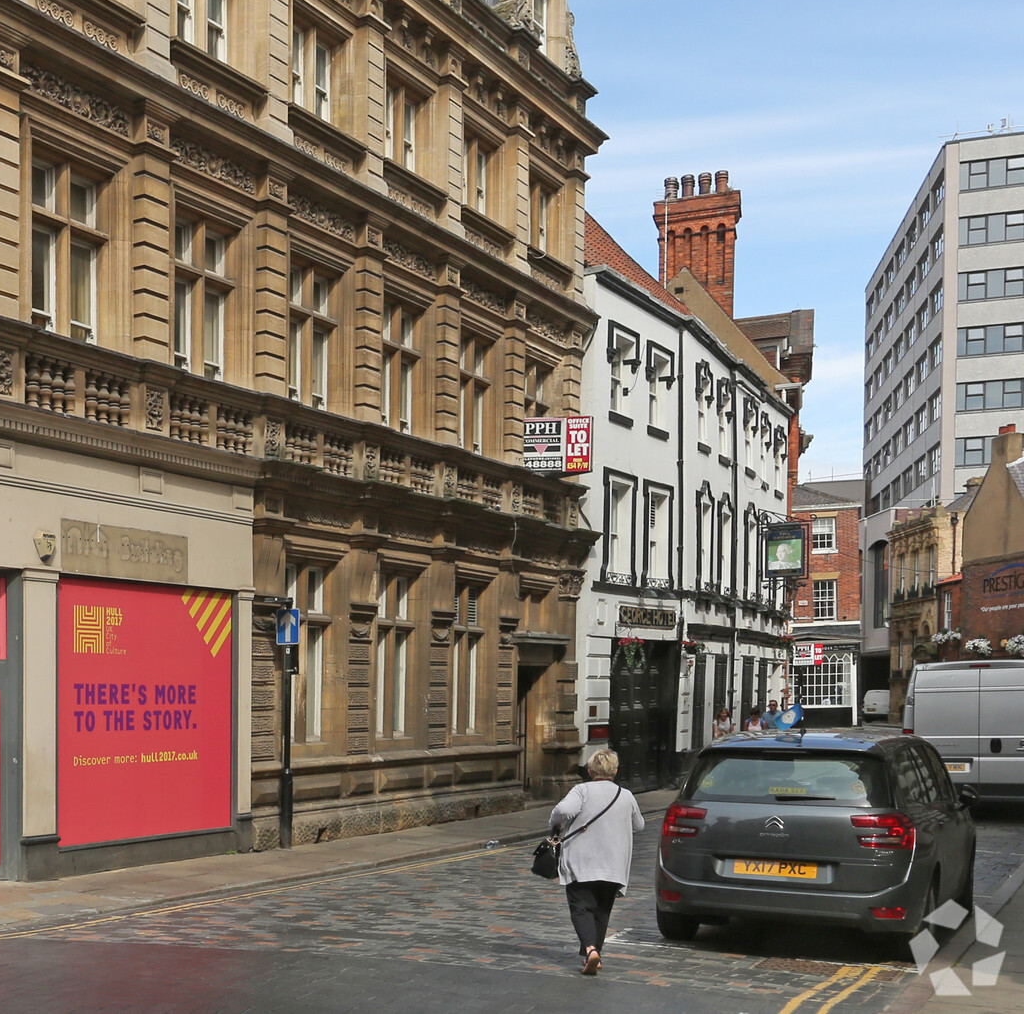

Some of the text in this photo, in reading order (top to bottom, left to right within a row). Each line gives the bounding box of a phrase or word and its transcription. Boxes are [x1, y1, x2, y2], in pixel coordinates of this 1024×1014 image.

[524, 422, 557, 435] PPH
[569, 429, 587, 444] TO
[567, 443, 589, 457] LET
[106, 607, 123, 617] HULL
[621, 607, 676, 626] GEORGE HOTEL
[106, 616, 123, 626] 2017
[106, 633, 117, 641] City
[74, 683, 197, 705] THERE'S MORE
[74, 709, 197, 732] TO THE STORY.
[73, 749, 198, 767] Discover more: hull2017.co.uk
[744, 861, 807, 876] YX17 PXC
